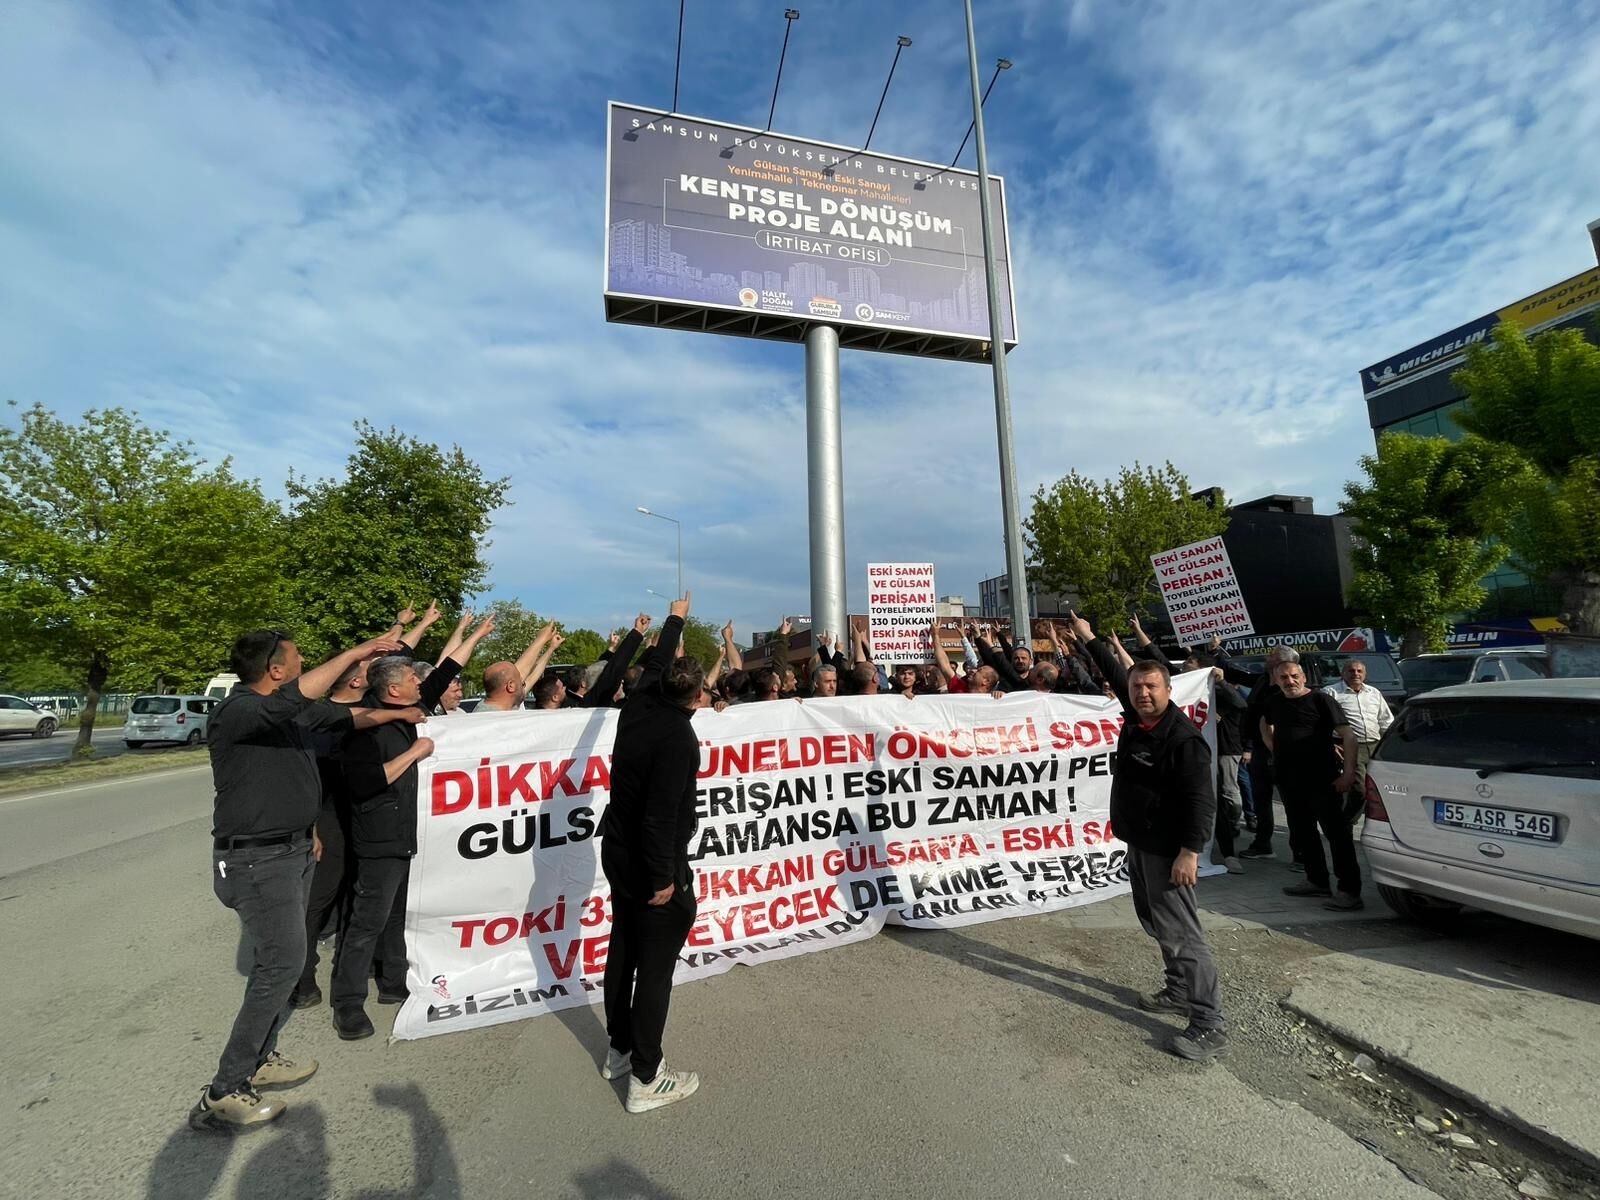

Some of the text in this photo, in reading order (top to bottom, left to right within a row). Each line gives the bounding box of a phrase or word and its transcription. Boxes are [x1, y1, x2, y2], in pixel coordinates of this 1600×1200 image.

[632, 118, 718, 142] SAMSUN
[877, 164, 978, 191] BELEDİYES
[727, 164, 793, 185] Yenimahalle
[753, 159, 790, 174] Gülsan
[834, 173, 856, 186] Eski
[857, 179, 891, 192] Sanayi
[680, 174, 951, 235] KENTSEL DÖNÜŞÜM
[729, 203, 820, 232] PROJE
[765, 232, 882, 263] İRTİBAT OFİSİ
[1399, 328, 1486, 373] MICHELIN
[1154, 538, 1224, 567] ESKİ SANAYİ
[870, 565, 933, 576] ESKİ SANAYİ
[1161, 554, 1224, 577] VE GÜLSAN
[873, 578, 931, 588] VE GÜLSAN
[1162, 566, 1232, 592] PERİŞAN !
[1165, 577, 1236, 602] TOYBELEN'DEKİ
[871, 591, 934, 606] PERİŞAN !
[871, 605, 935, 613] TOYBELEN'DEKİ
[1168, 589, 1240, 613] 330 DÜKKANI
[1173, 599, 1243, 623] ESKİ SANAYİ
[871, 618, 889, 626] 330
[872, 627, 931, 638] ESKİ SANAY
[1178, 613, 1245, 635] ESNAFI İÇİN
[1181, 633, 1201, 644] ACİL
[1202, 624, 1250, 640] İSTİYORUZ
[874, 642, 911, 651] ESNAFI
[1224, 631, 1342, 651] ATILIM OTOMOTİV
[874, 651, 892, 660] ACİL
[431, 755, 612, 816] DİKKA
[695, 733, 876, 779] ÜNELDEN
[886, 717, 1039, 761] ÖNCEKİ
[457, 808, 608, 860] GÜLS
[694, 776, 817, 819] ERİŞAN
[825, 774, 834, 801] !
[843, 761, 922, 798] ESKİ
[932, 753, 1058, 791] SANAYİ
[867, 799, 916, 832] BU
[928, 789, 1058, 826] ZAMAN
[1067, 786, 1077, 812] !
[1445, 804, 1465, 821] 55
[1473, 809, 1506, 828] ASR
[1514, 814, 1550, 834] 546
[451, 895, 566, 948] TOKİ
[1002, 818, 1075, 854] ESKİ
[543, 934, 611, 980] VE
[687, 884, 841, 947] EYECEK
[849, 875, 904, 911] DE
[909, 861, 1008, 899] KİME
[427, 984, 568, 1023] BİZİM
[676, 929, 826, 969] YAPILAN
